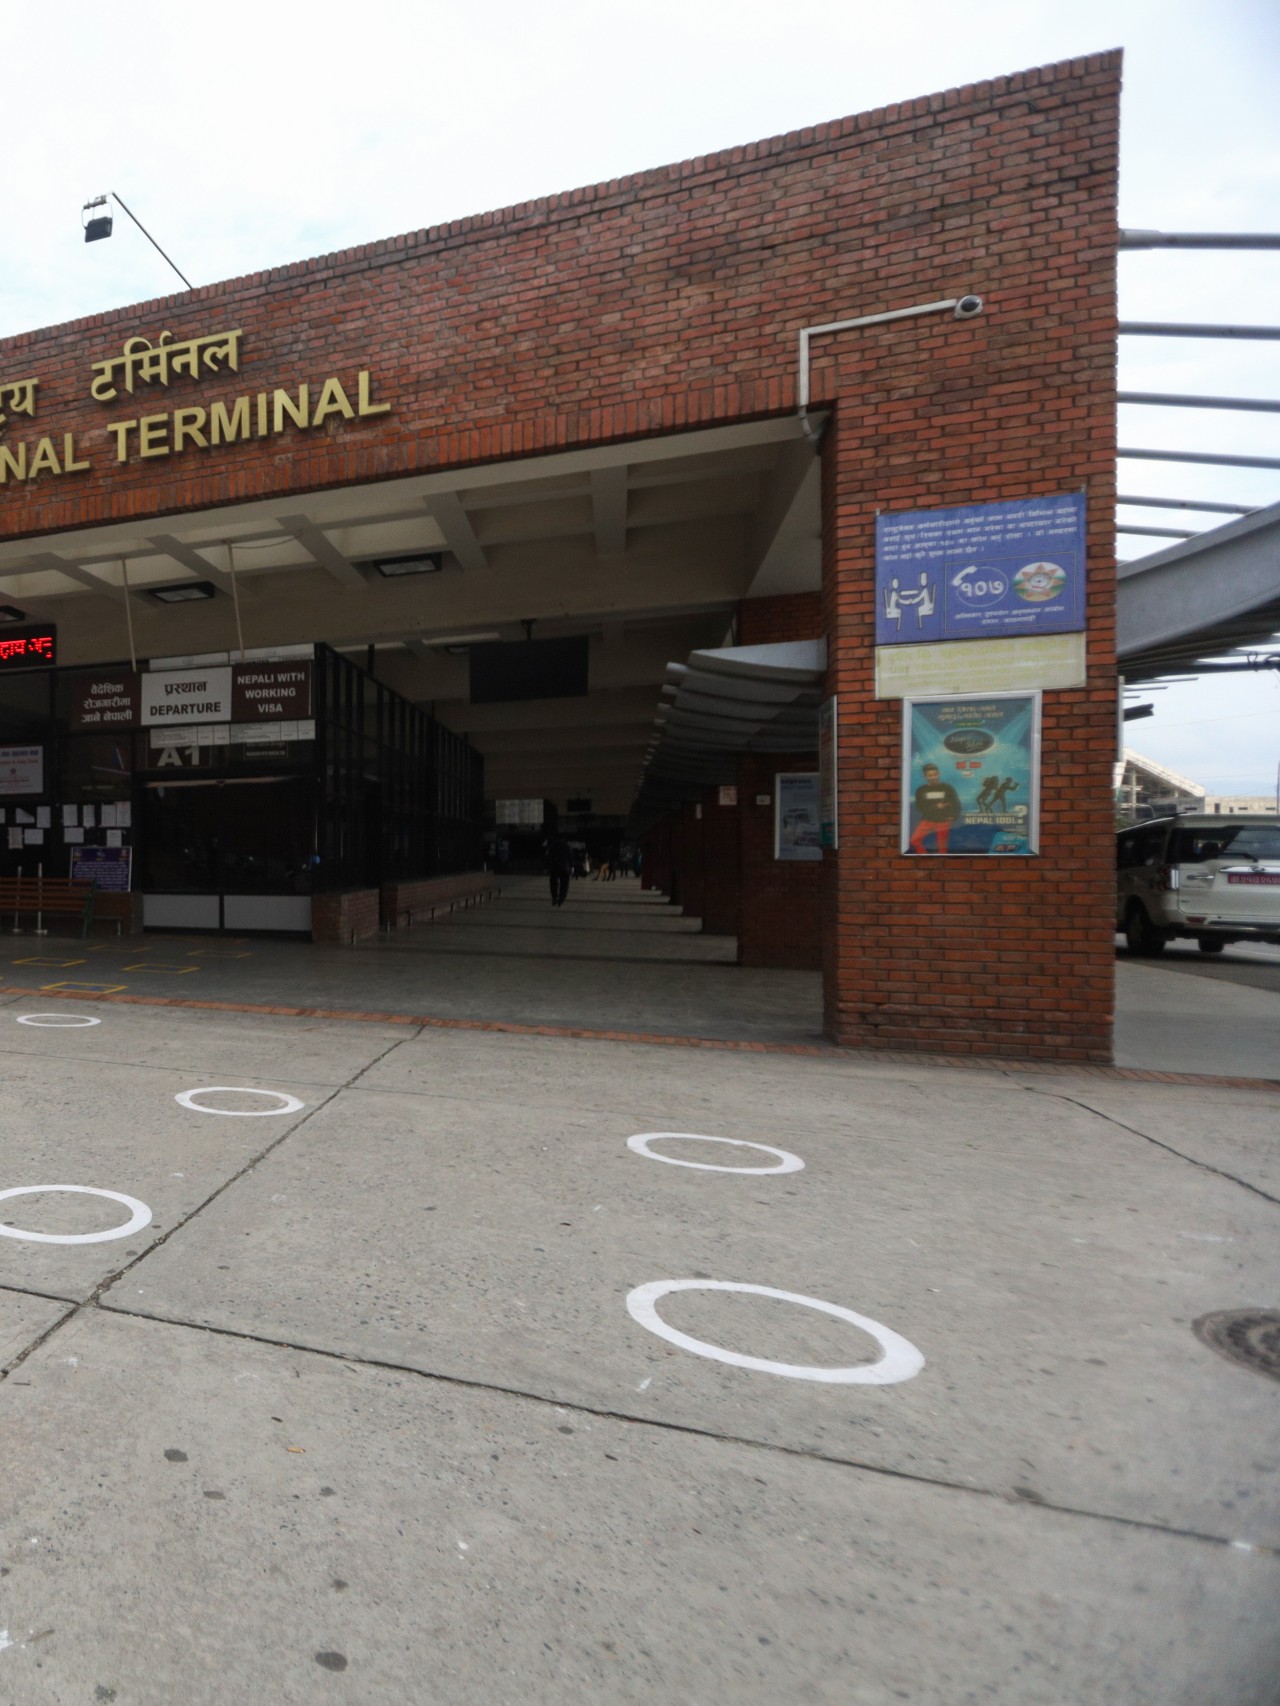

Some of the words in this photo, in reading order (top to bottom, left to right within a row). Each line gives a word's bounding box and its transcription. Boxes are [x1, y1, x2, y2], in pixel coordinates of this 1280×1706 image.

[90, 329, 242, 400] टर्मिनल
[107, 370, 391, 462] TERMINAL
[960, 580, 1004, 597] १०७
[237, 674, 274, 685] NEPALI
[277, 671, 305, 682] WITH
[164, 681, 208, 696] प्रस्थान
[245, 687, 297, 699] WORKING
[150, 702, 222, 716] DEPARTURE
[257, 702, 283, 713] VISA
[103, 709, 132, 721] नेपाली
[157, 746, 200, 767] A1
